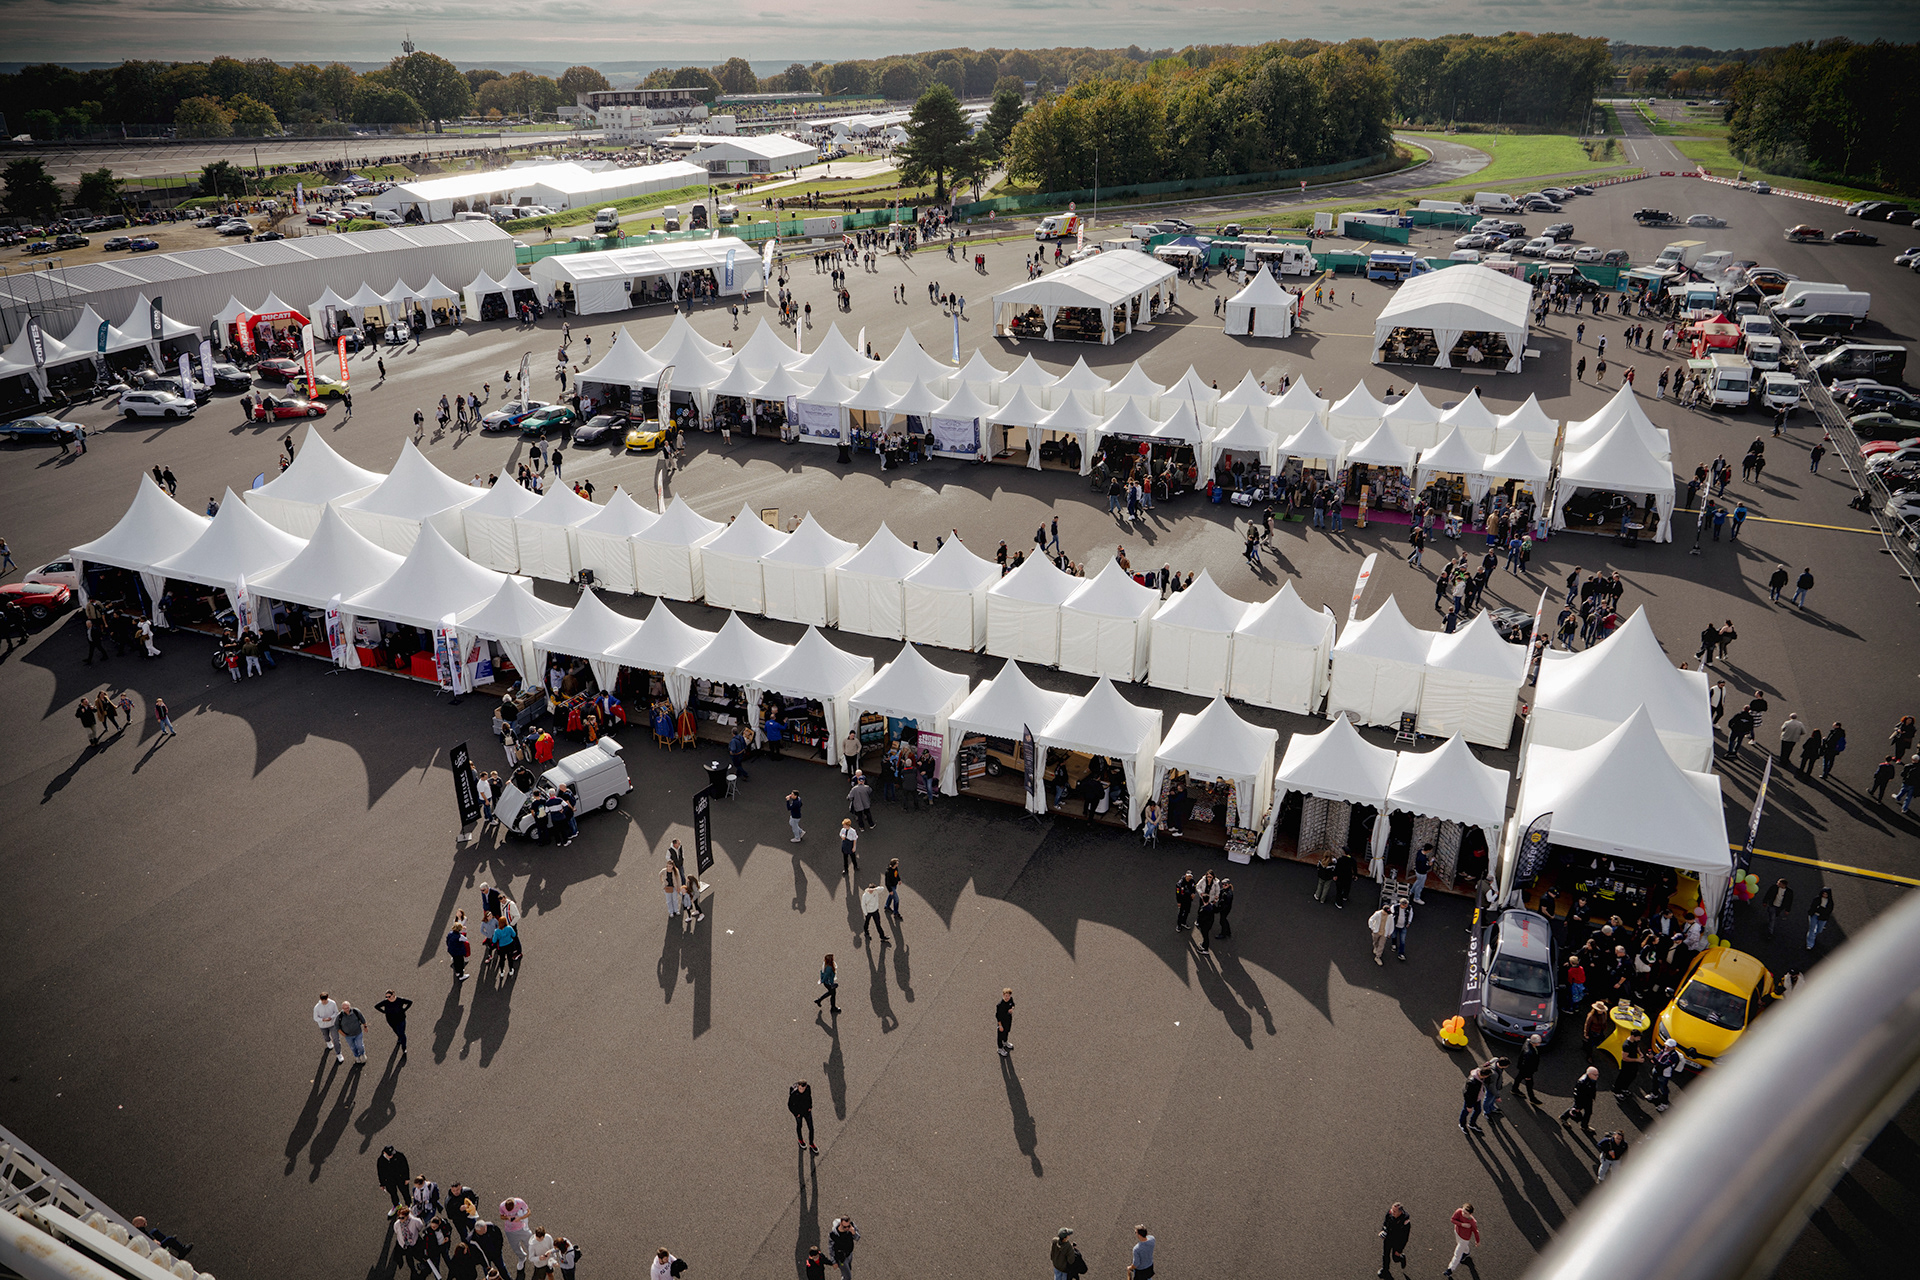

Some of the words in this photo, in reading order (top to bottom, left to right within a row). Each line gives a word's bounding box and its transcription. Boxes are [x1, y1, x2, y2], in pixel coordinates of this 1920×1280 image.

[261, 312, 291, 321] DUCATI
[31, 324, 44, 363] ZONTES
[239, 322, 250, 353] DUCATI
[305, 355, 315, 389] HONDA
[460, 772, 470, 808] BOUTIQUE
[1746, 807, 1762, 853] Exosfer
[1523, 845, 1538, 877] Exosfer
[1467, 936, 1478, 991] Exosfer
